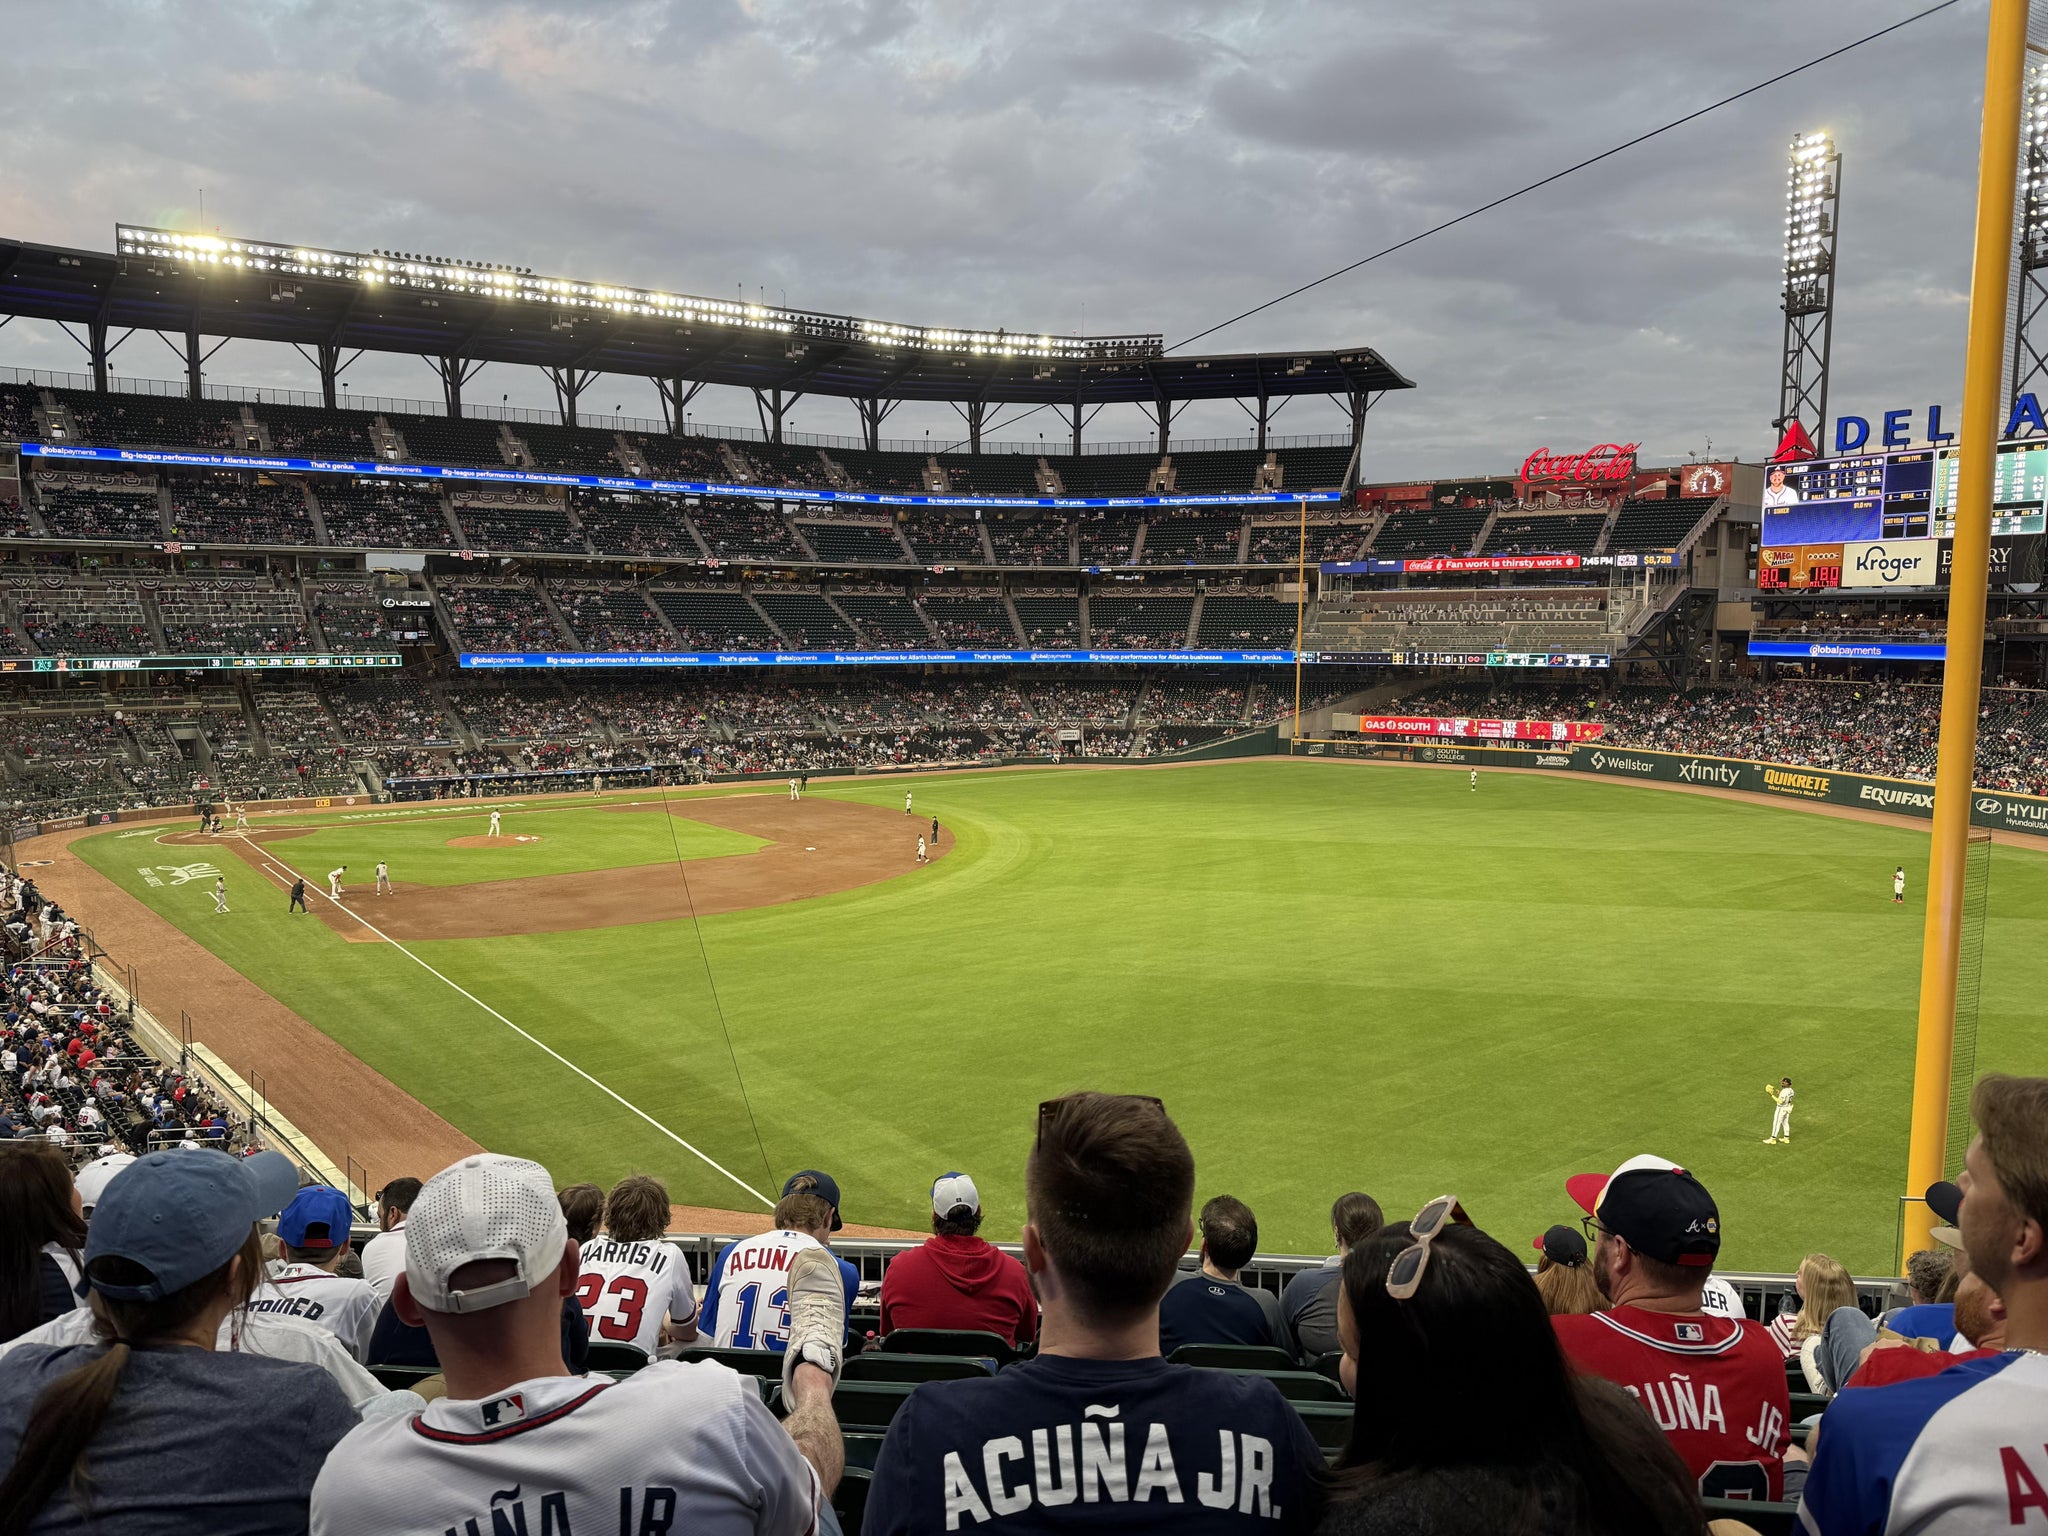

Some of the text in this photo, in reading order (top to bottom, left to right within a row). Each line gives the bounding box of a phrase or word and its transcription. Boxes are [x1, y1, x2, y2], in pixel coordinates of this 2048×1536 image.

[1835, 392, 2048, 451] DELA
[121, 452, 161, 461] Big-league
[211, 457, 221, 465] for
[223, 458, 248, 466] Atlanta
[250, 460, 288, 468] businesses
[1520, 442, 1642, 484] Coca-Cola
[332, 464, 356, 472] genius.
[442, 470, 475, 478] Big-league
[476, 472, 514, 480] performance
[1856, 487, 1866, 496] 23
[164, 542, 181, 553] 35
[460, 550, 473, 560] 41
[1582, 557, 1599, 565] 7:45
[1774, 552, 1794, 560] MEGA
[1942, 548, 2012, 565] ERY
[706, 559, 719, 568] 44
[1502, 559, 1535, 568] thirsty
[1857, 546, 1921, 582] Kroger
[1762, 569, 1778, 582] 80
[1815, 567, 1839, 580] 180
[1387, 602, 1592, 620] HANK AARON TERRACE
[93, 660, 111, 669] MAX
[112, 660, 140, 669] MUNCY
[547, 657, 584, 666] Big-league
[640, 657, 662, 665] Atlanta
[664, 657, 698, 665] businesses
[1366, 721, 1430, 731] GAS SOUTH
[1438, 723, 1451, 732] AL
[1608, 756, 1654, 773] Wellstar
[1678, 759, 1740, 786] xfinity
[1764, 769, 1830, 792] QUIKRETE
[1781, 787, 1803, 795] America's
[1860, 785, 1935, 808] EQUIFAX
[580, 1242, 667, 1274] HARRIS II
[576, 1273, 648, 1342] 23
[1624, 1373, 1726, 1434] UÑA
[944, 1404, 1281, 1531] ACUÑA JR.
[2000, 1443, 2048, 1525] A
